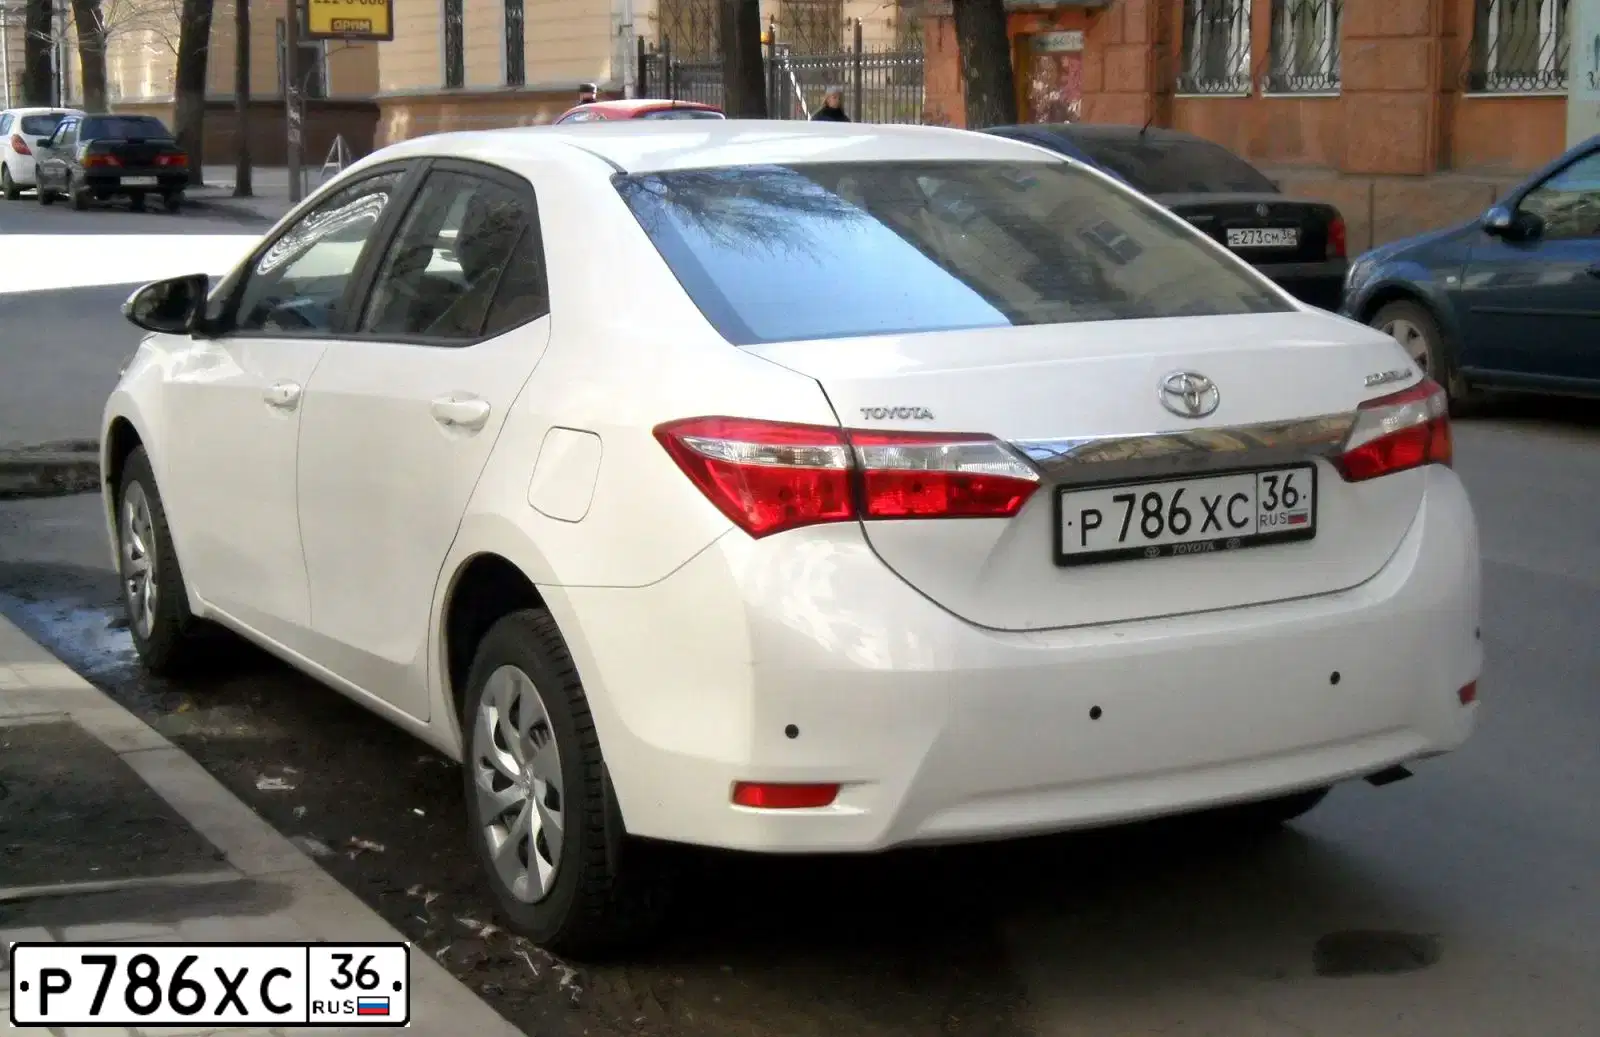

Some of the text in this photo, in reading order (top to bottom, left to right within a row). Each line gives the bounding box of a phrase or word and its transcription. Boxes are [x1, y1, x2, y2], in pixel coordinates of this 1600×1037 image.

[860, 406, 934, 420] TOYOTA
[1262, 473, 1299, 511] 36
[1260, 512, 1287, 527] RUS
[1171, 541, 1215, 556] TOYOTA
